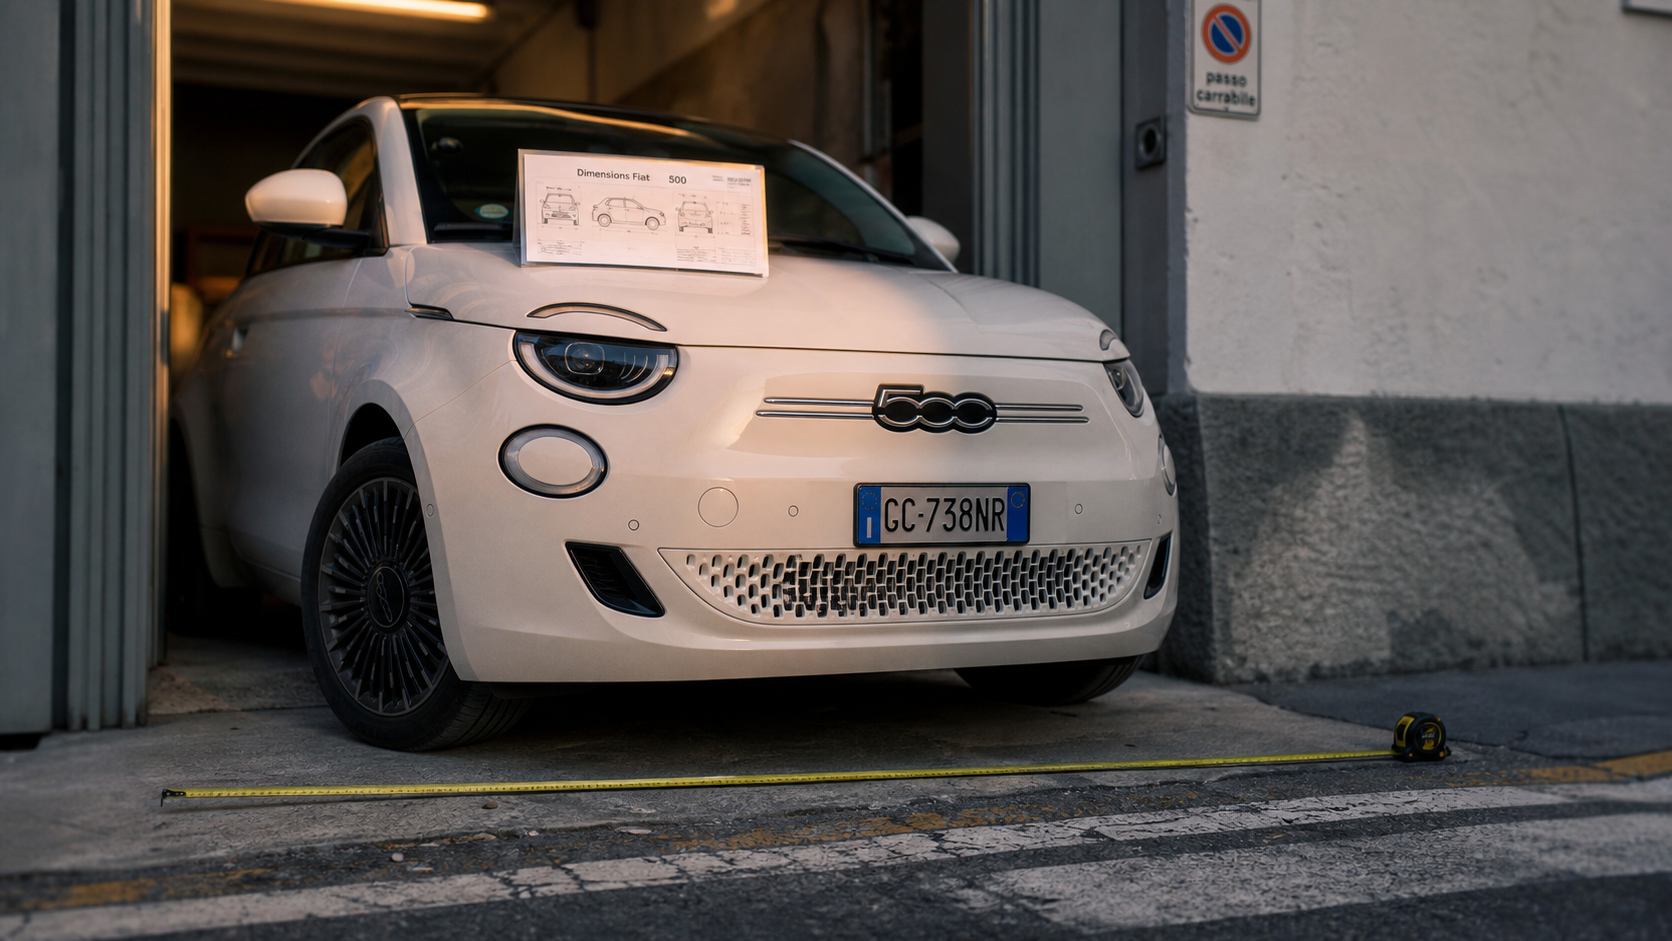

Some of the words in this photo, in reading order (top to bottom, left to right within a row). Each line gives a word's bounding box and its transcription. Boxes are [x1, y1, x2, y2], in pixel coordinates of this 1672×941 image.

[1206, 72, 1247, 88] passo
[1196, 89, 1256, 107] carrabile
[577, 168, 630, 180] Dimensions
[632, 172, 650, 182] Fiat
[668, 175, 687, 185] 500
[876, 386, 995, 430] 500
[884, 497, 1005, 533] GC-738NR
